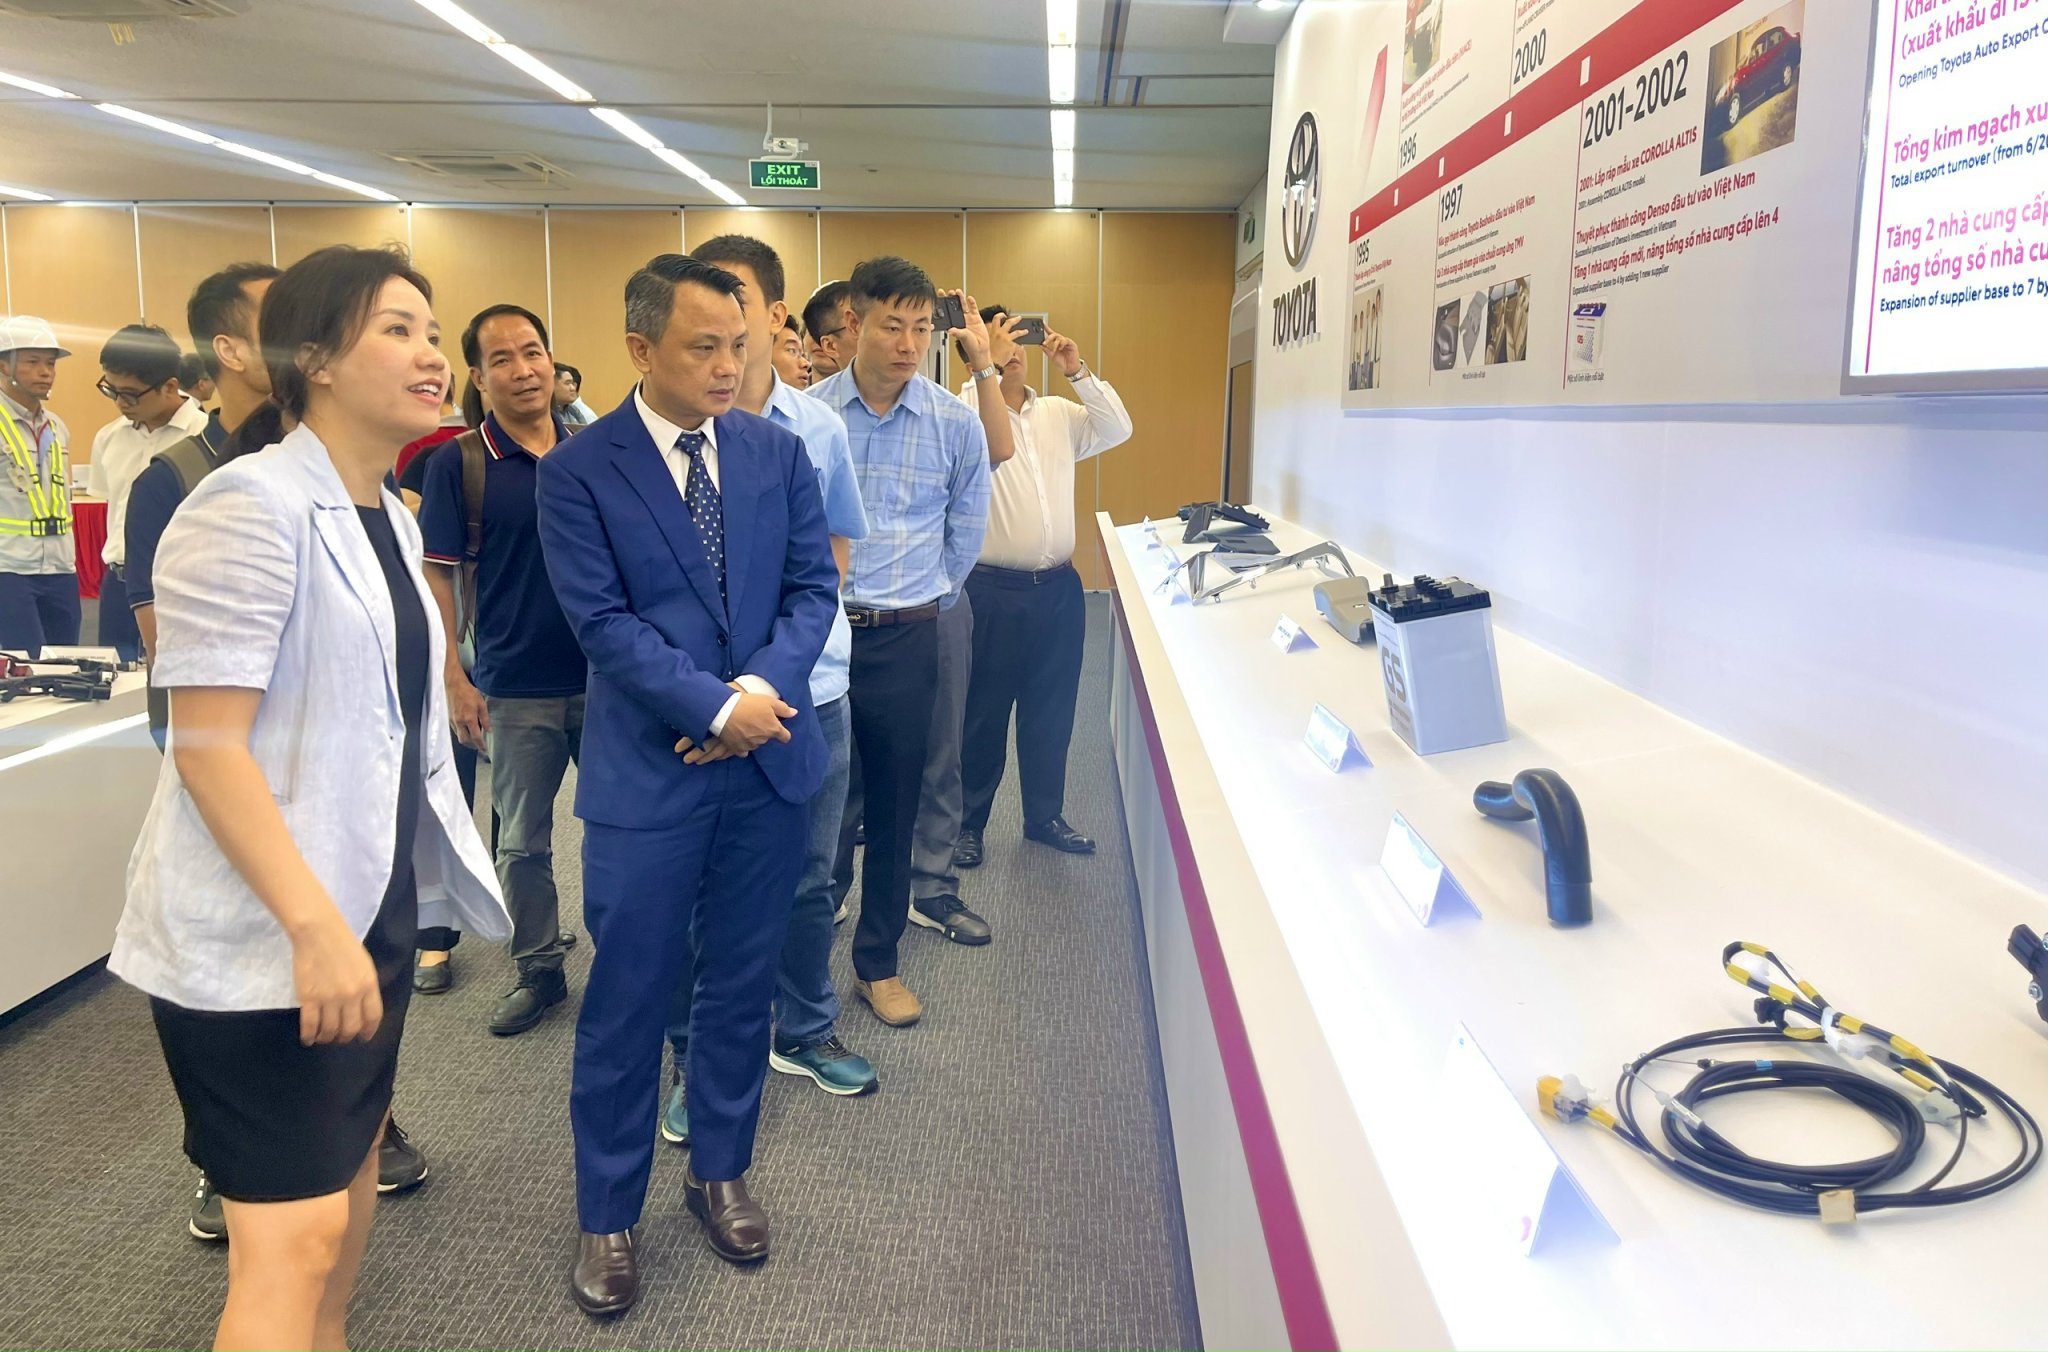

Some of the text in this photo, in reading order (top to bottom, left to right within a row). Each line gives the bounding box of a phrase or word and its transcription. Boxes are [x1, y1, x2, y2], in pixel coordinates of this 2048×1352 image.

[1899, 64, 1938, 88] Opening
[1940, 51, 1972, 73] Toyota
[1973, 40, 2000, 60] Auto
[2002, 23, 2039, 50] Export
[1902, 19, 1942, 60] (xuất
[1945, 0, 1986, 39] khẩu
[1514, 28, 1546, 85] 2000
[1583, 50, 1688, 149] 2001-2002
[1400, 132, 1417, 169] 1996
[1631, 157, 1640, 169] xe
[1640, 136, 1675, 165] COROLLA
[1675, 126, 1697, 150] ALTIS
[1894, 134, 1930, 163] Tổng
[1933, 125, 1963, 152] kim
[1967, 104, 2021, 146] ngạch
[760, 174, 808, 185] LỐI THOÁT
[767, 164, 801, 175] EXIT
[1891, 170, 1912, 189] Total
[1914, 163, 1946, 183] export
[1948, 151, 1992, 174] turnover
[1993, 143, 2023, 164] (from
[1441, 183, 1463, 223] 1997
[1611, 212, 1629, 234] thành
[1630, 209, 1647, 226] công
[1647, 202, 1670, 220] Denso
[1671, 193, 1686, 212] đầu
[1687, 189, 1697, 206] tư
[1697, 184, 1712, 203] vào
[1714, 177, 1732, 199] Việt
[1733, 171, 1756, 191] Nam
[1887, 224, 1922, 250] Tăng
[1925, 218, 1935, 241] 2
[1939, 210, 1969, 239] nhà
[1973, 206, 2017, 233] cung
[1602, 256, 1617, 272] cung
[1646, 242, 1665, 260] nâng
[1685, 229, 1695, 248] số
[1695, 226, 1712, 246] nhà
[1713, 223, 1735, 241] cung
[1736, 213, 1753, 236] cấp
[1754, 209, 1770, 230] lên
[1772, 206, 1779, 224] 4
[1883, 259, 1920, 285] nâng
[1924, 248, 1962, 280] tổng
[1966, 241, 1988, 271] số
[1990, 238, 2024, 268] nhà
[1273, 276, 1317, 347] TOYOTA
[1880, 294, 1926, 315] Expansion
[1928, 290, 1939, 306] of
[1940, 286, 1982, 307] supplier
[1984, 283, 2010, 300] base
[2012, 281, 2024, 297] to
[2027, 278, 2035, 295] 7
[1381, 646, 1407, 703] GS
